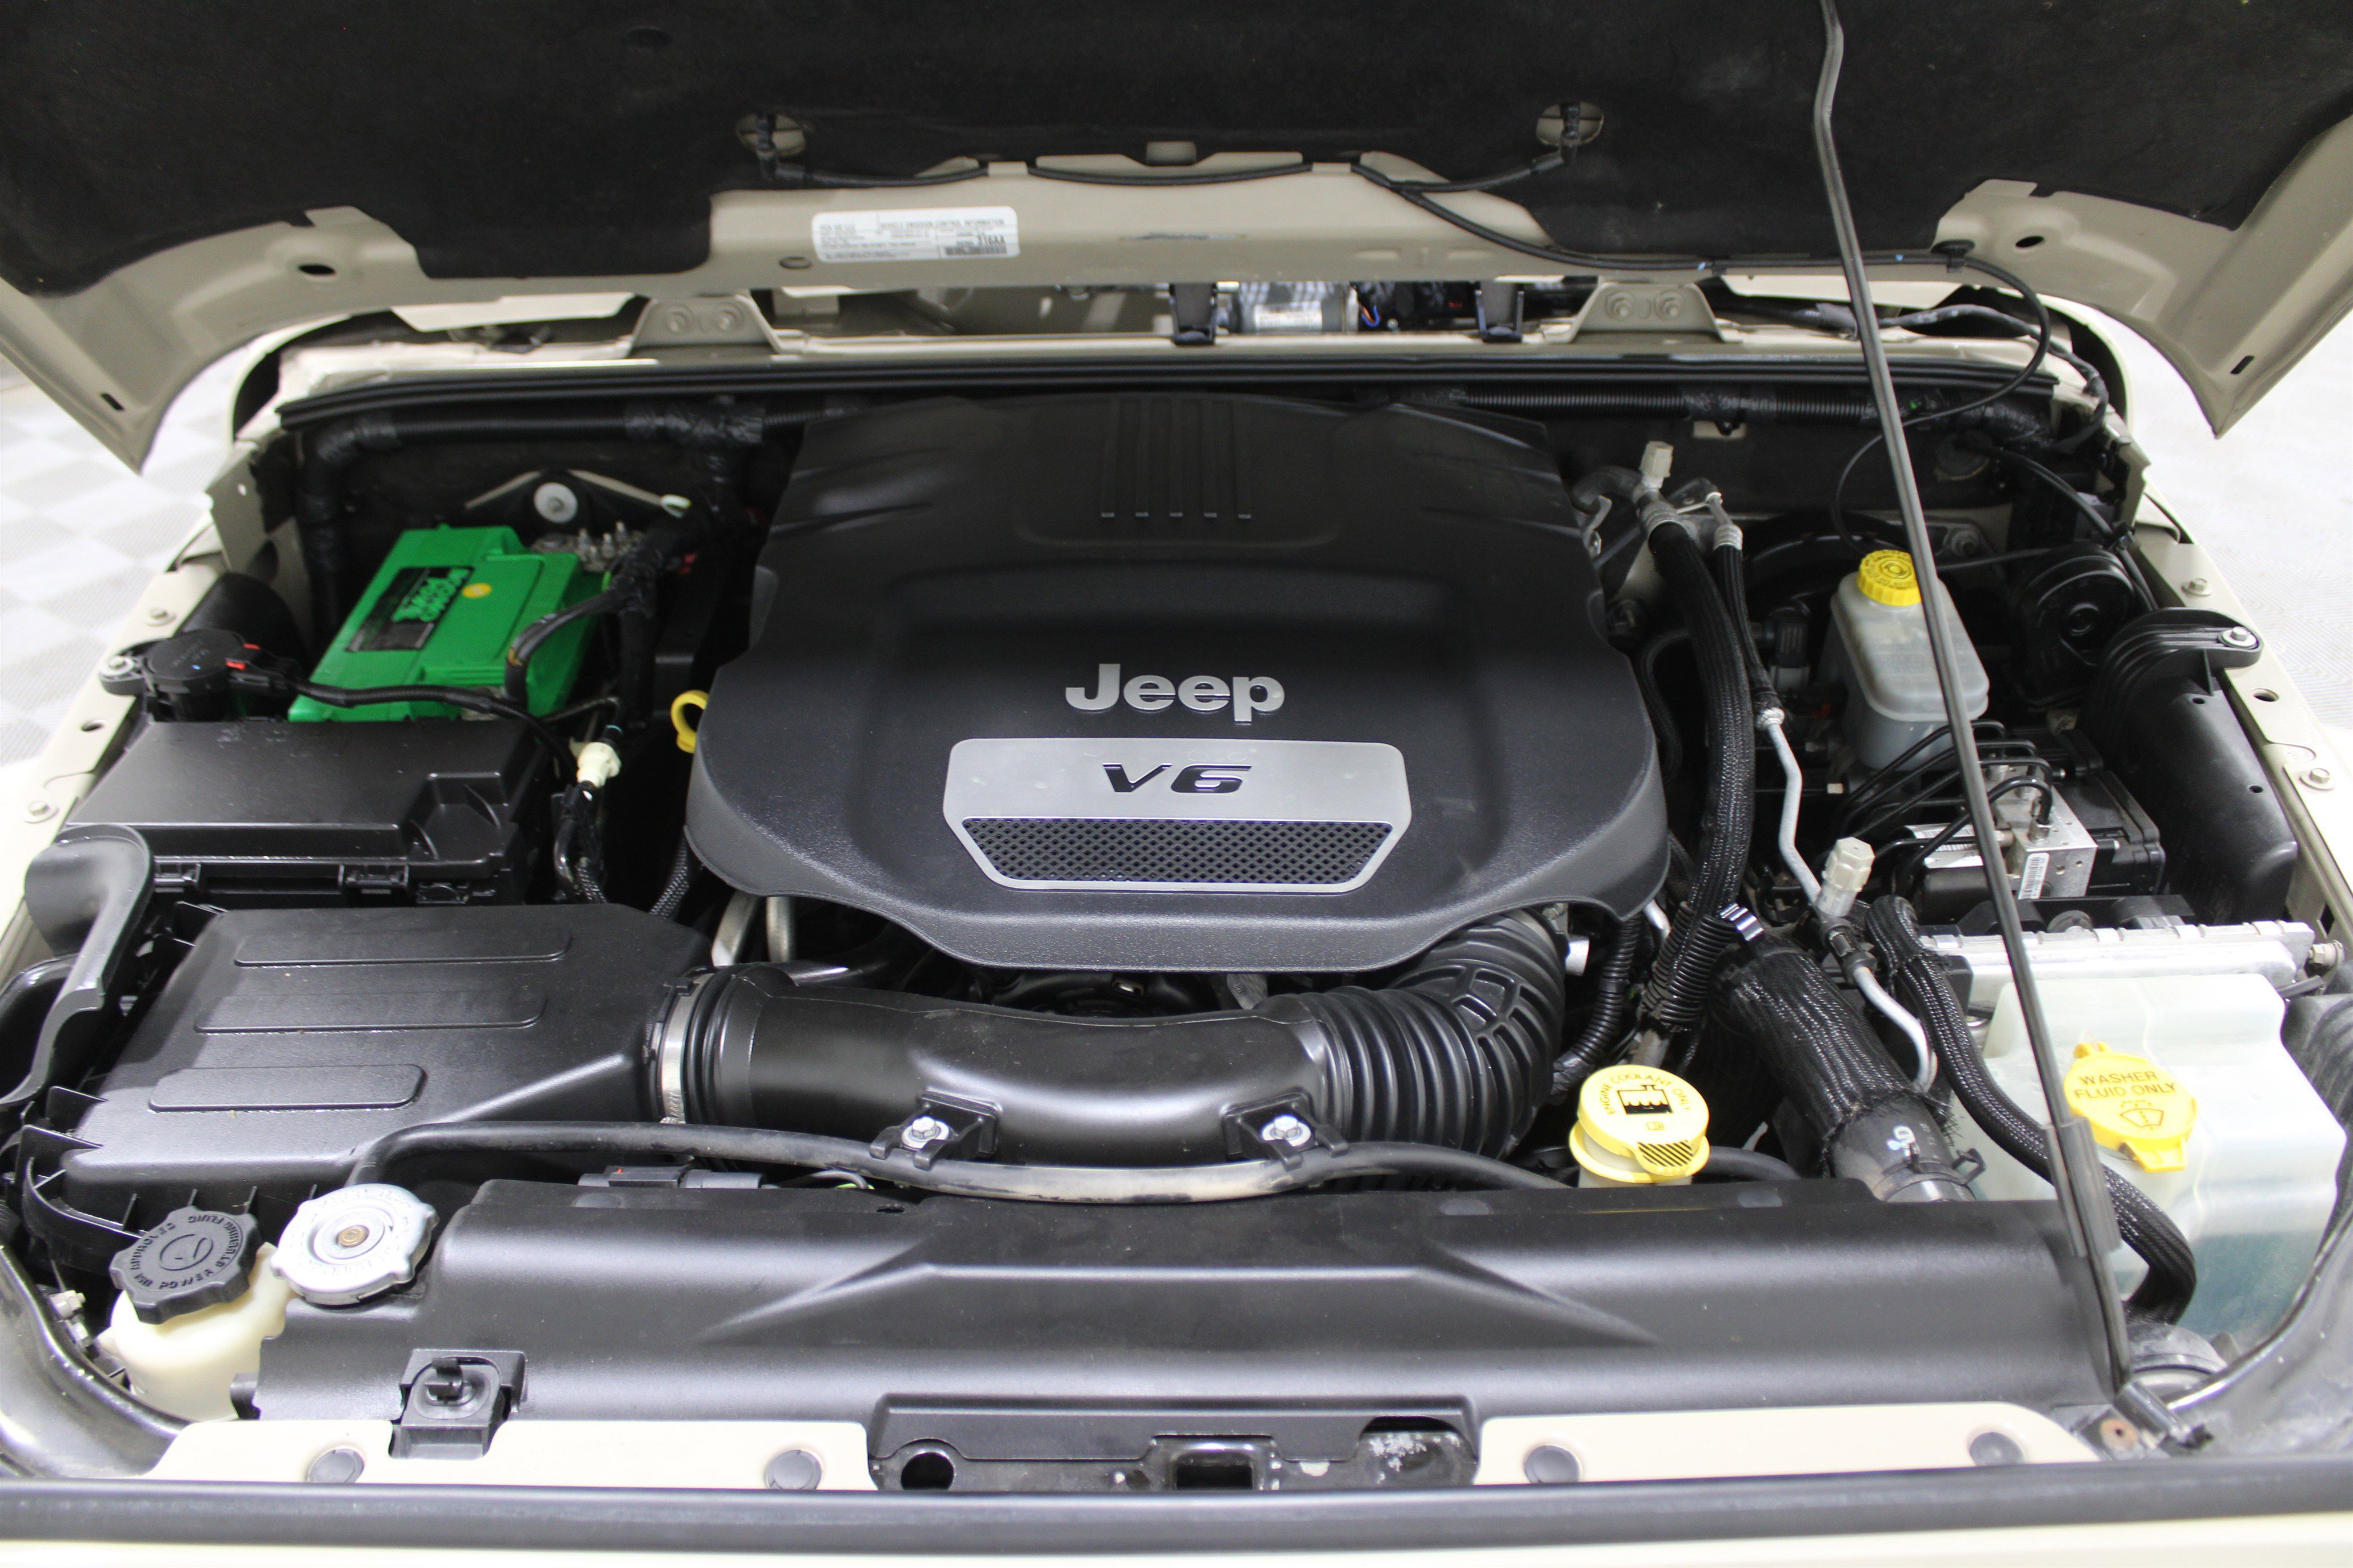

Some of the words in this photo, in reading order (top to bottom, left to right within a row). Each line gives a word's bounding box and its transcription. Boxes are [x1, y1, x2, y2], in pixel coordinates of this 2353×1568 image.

[1065, 663, 1285, 725] Jeep
[1102, 762, 1252, 793] V6
[2074, 1087, 2126, 1099] FLUID
[2131, 1082, 2177, 1095] ONLY
[2079, 1071, 2158, 1085] WASHER
[1600, 1083, 1616, 1115] ENGINE
[1610, 1073, 1672, 1087] COOLANT
[1673, 1088, 1691, 1111] ONLY
[187, 1214, 225, 1224] FLUID
[215, 1221, 240, 1268] STEERING
[159, 1268, 214, 1289] POWER
